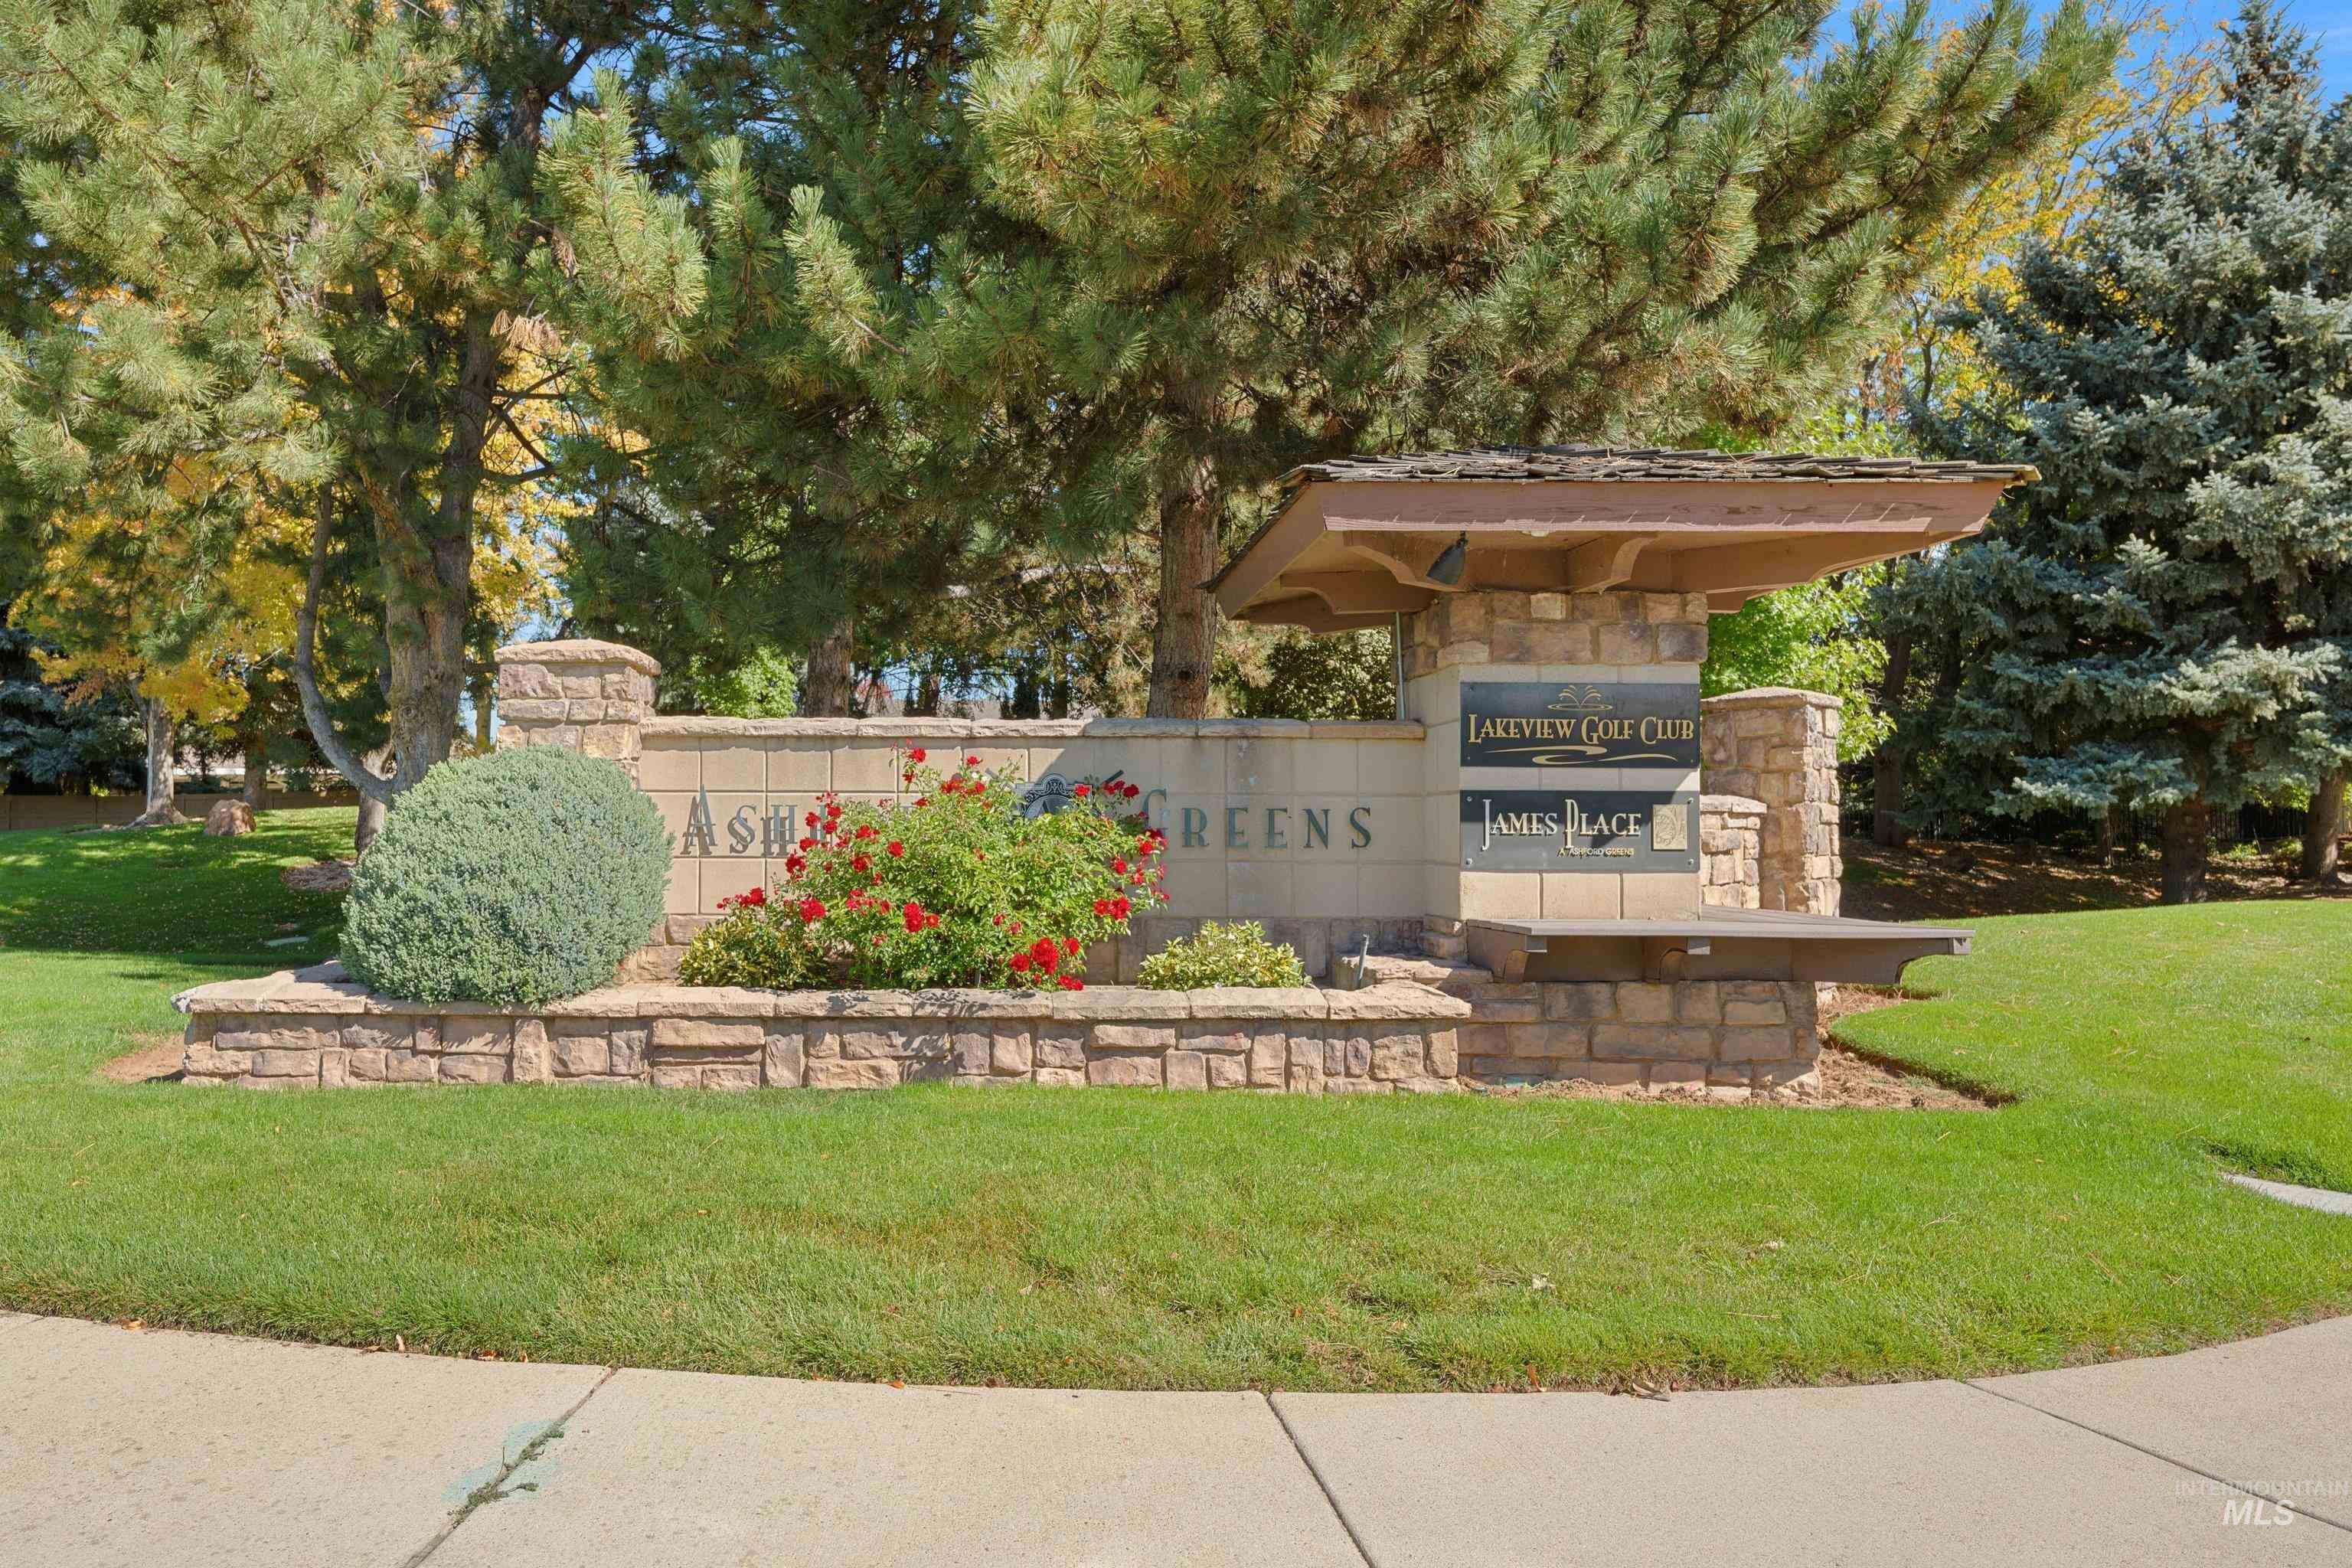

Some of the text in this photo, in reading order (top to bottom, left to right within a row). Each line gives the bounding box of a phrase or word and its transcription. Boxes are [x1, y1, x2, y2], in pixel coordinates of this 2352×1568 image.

[1468, 714, 1694, 745] LAKEVIEW GOLF CLUB
[1481, 799, 1642, 851] JAMES PLACE
[1605, 847, 1635, 856] GREENS
